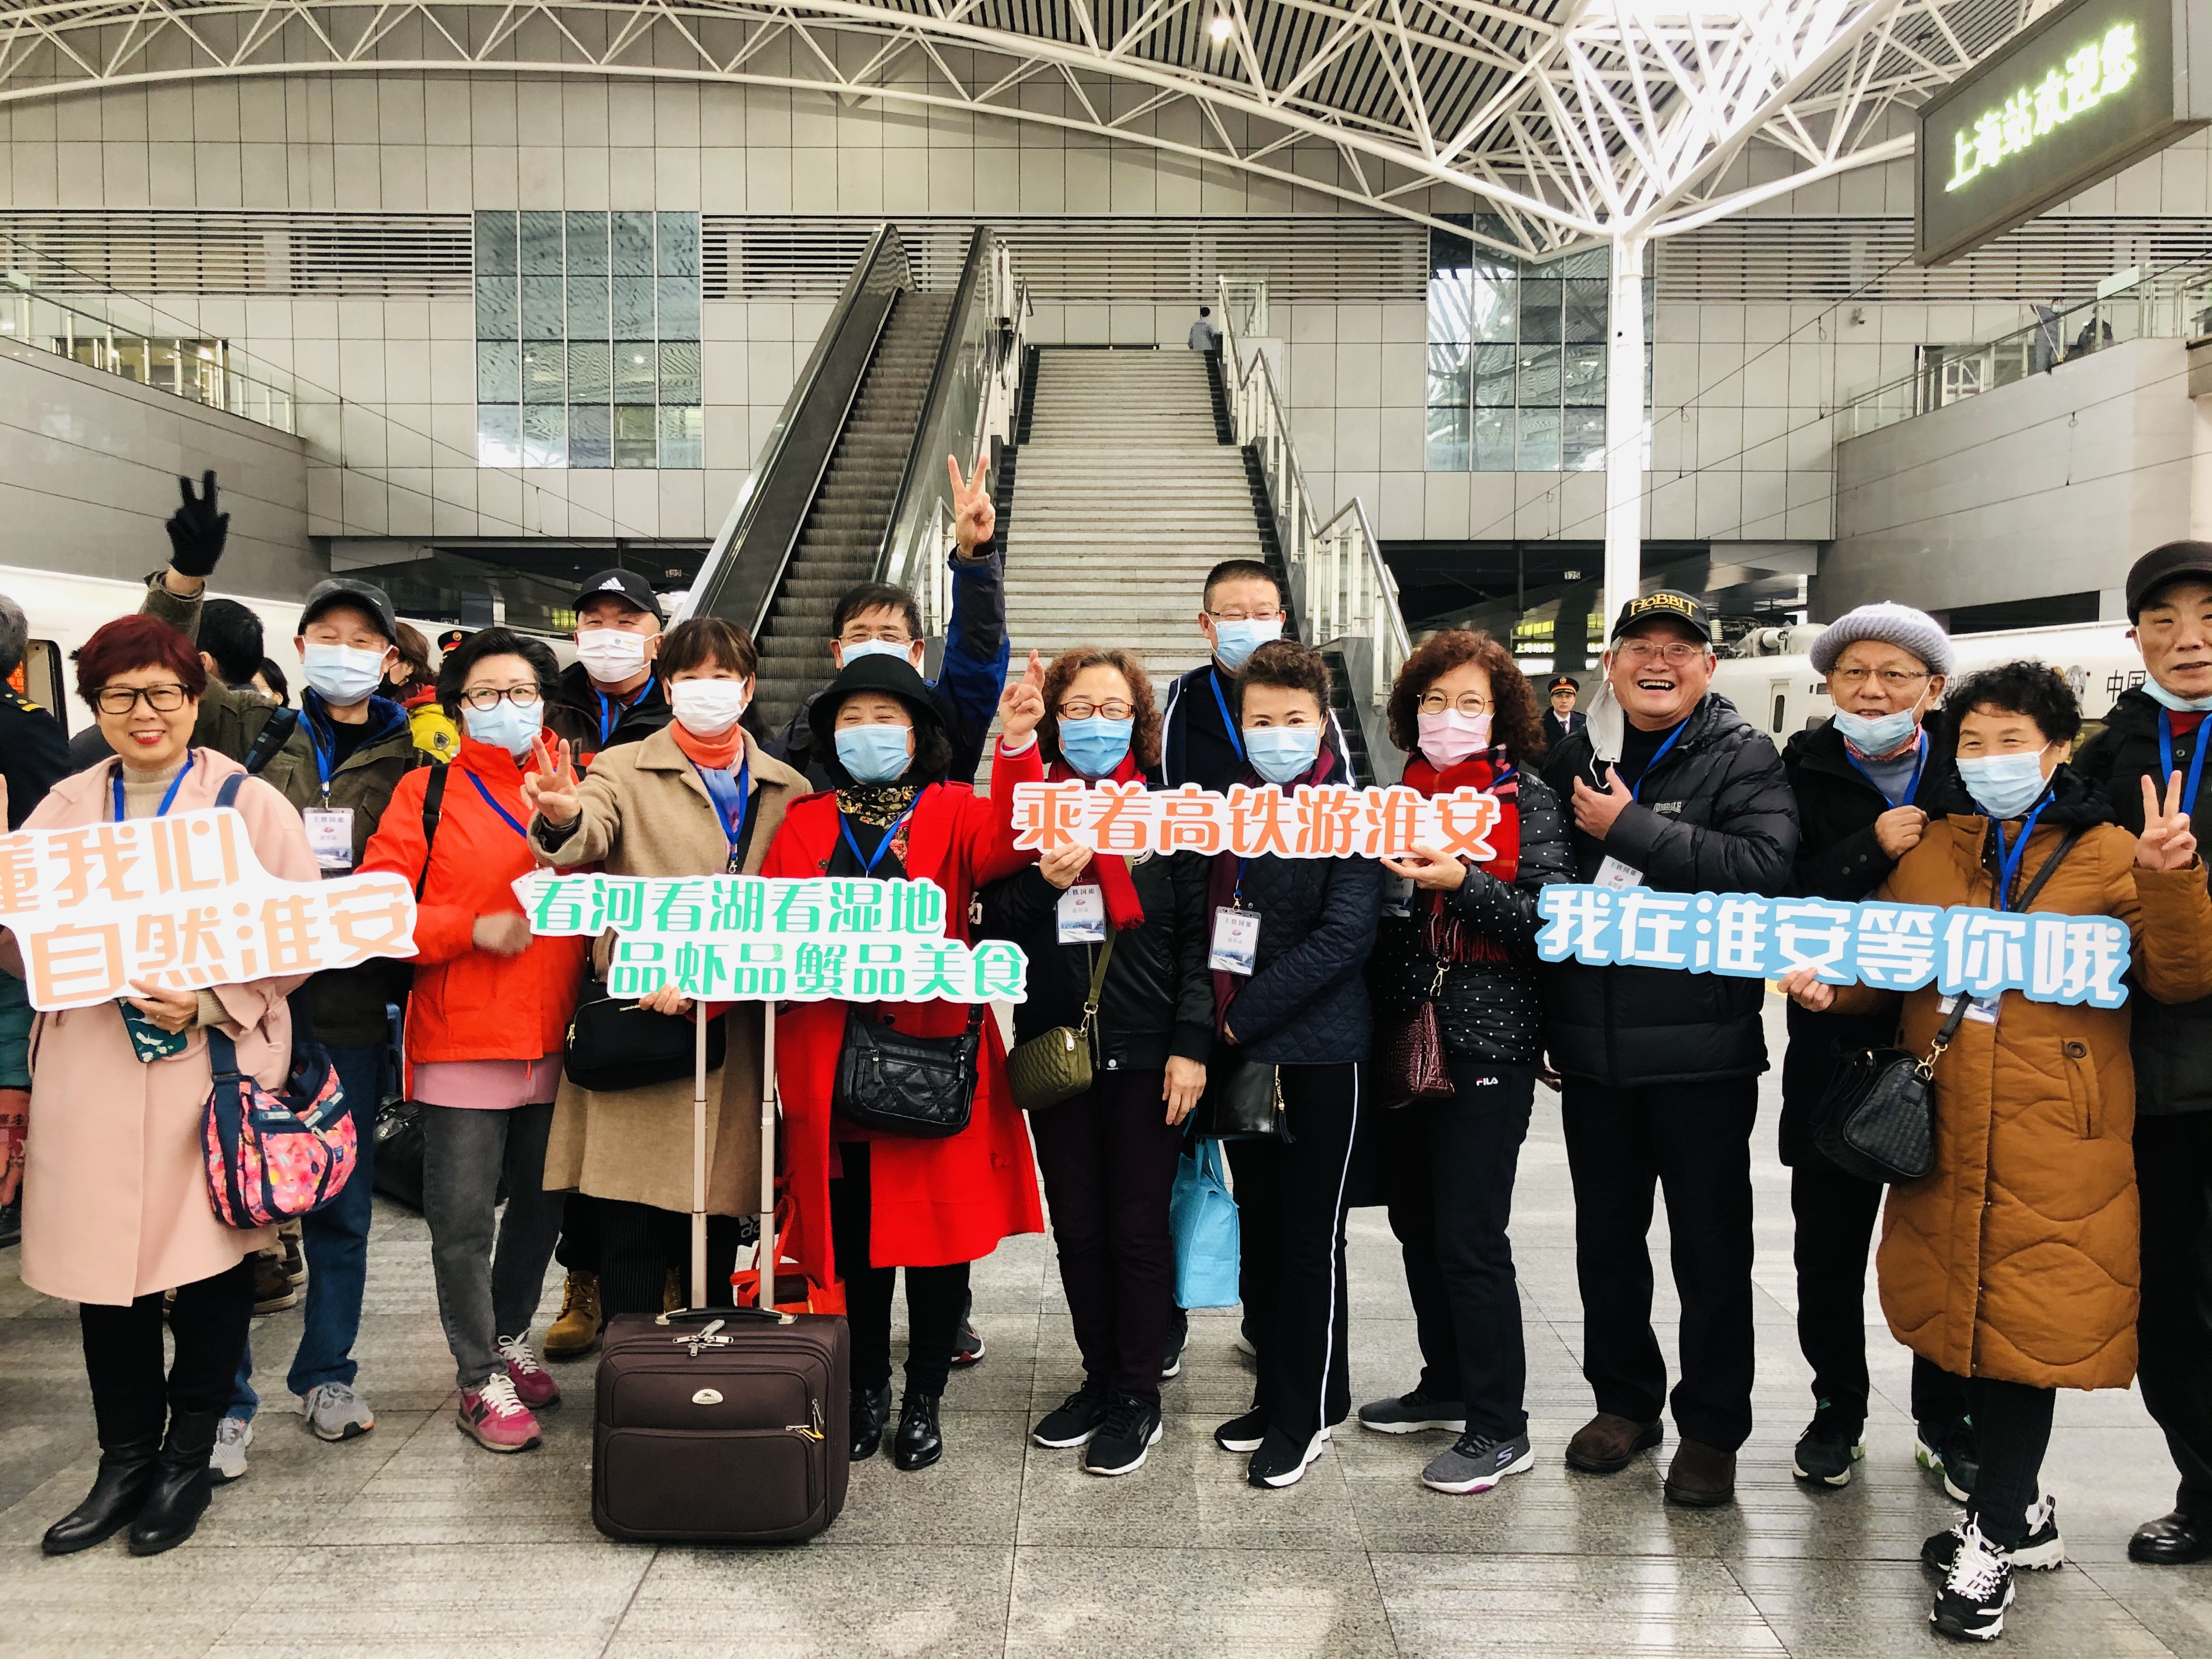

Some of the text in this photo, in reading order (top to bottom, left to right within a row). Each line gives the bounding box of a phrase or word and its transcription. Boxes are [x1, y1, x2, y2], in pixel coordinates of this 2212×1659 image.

[1945, 24, 2137, 192] 上海站欢迎您
[1629, 594, 1699, 617] HOBBIT
[1017, 785, 1497, 855] 乘着高铁游淮安
[530, 879, 941, 934] 看河看湖看湿地
[30, 883, 415, 1006] 自然淮安
[614, 941, 1023, 997] 品虾品蟹品美食
[1543, 890, 2121, 1001] 我在淮安等你哦
[1476, 1077, 1499, 1086] FILA
